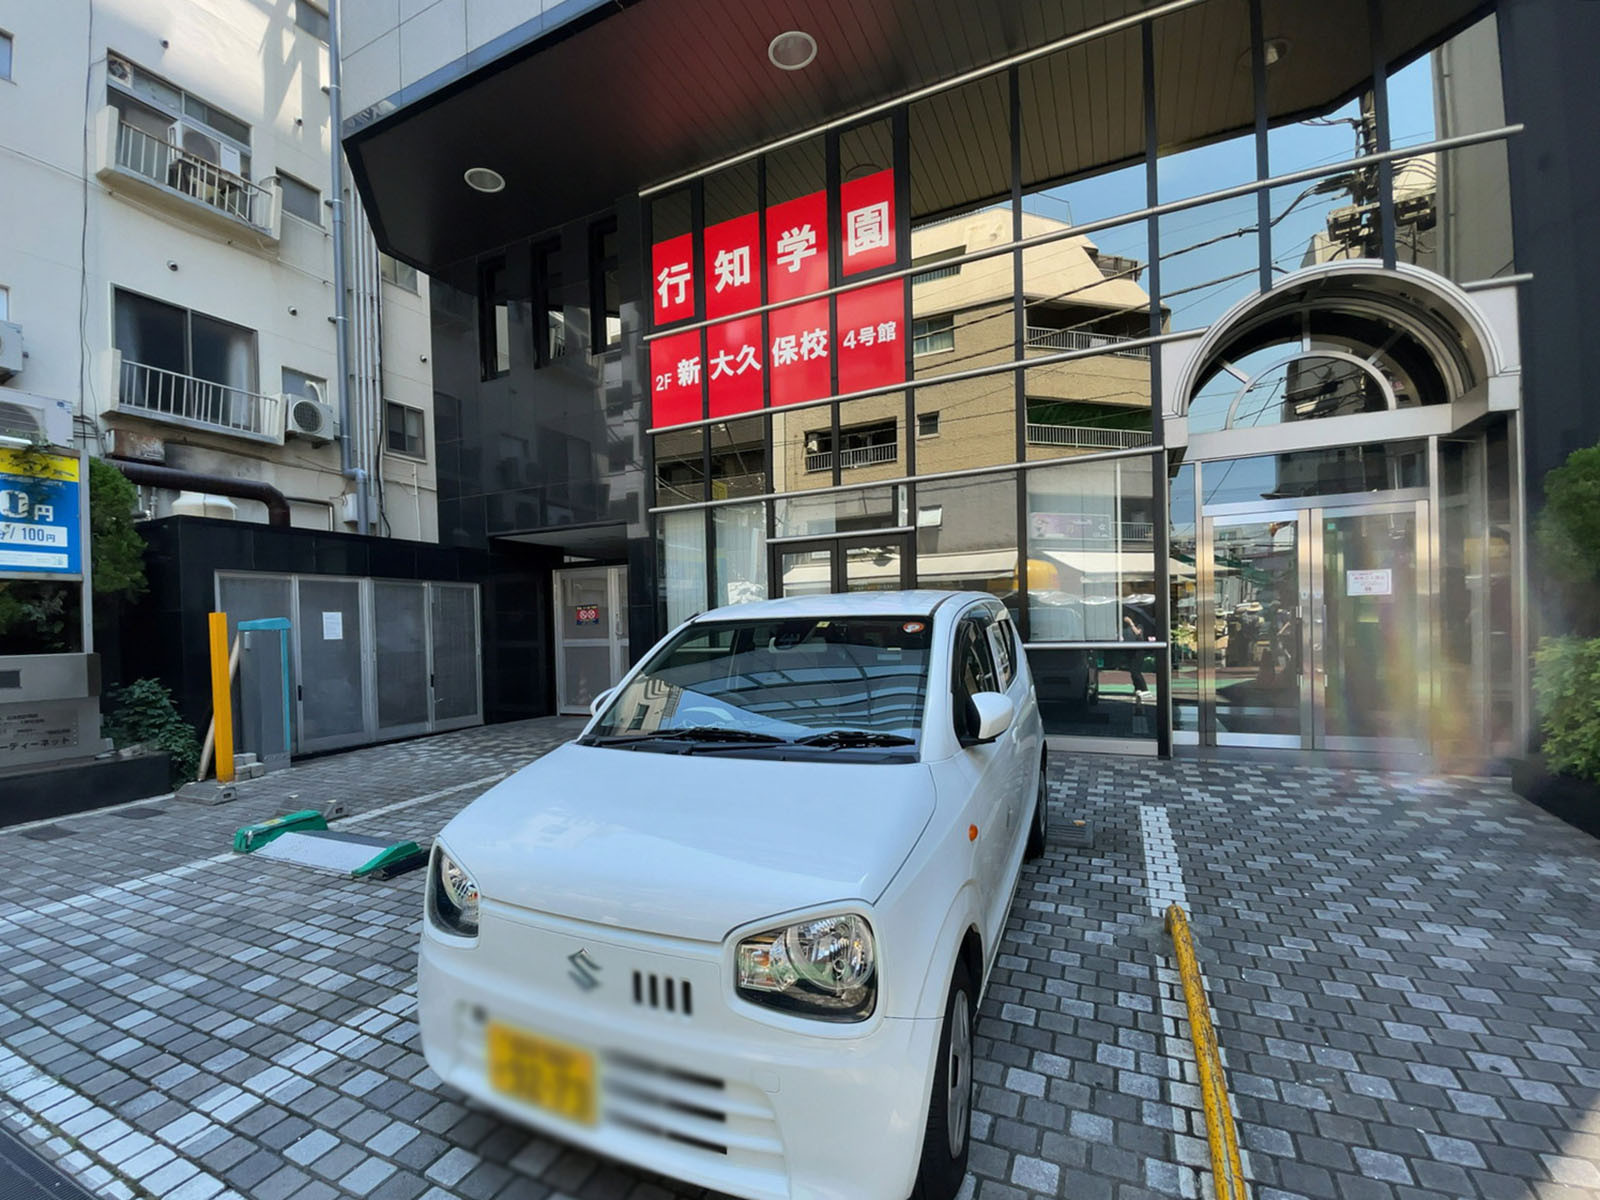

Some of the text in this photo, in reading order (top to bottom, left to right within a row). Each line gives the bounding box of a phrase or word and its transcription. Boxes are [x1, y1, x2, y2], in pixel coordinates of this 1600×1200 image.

[657, 201, 889, 308] 行知学園
[655, 373, 673, 391] 2F
[843, 320, 897, 349] 4号館
